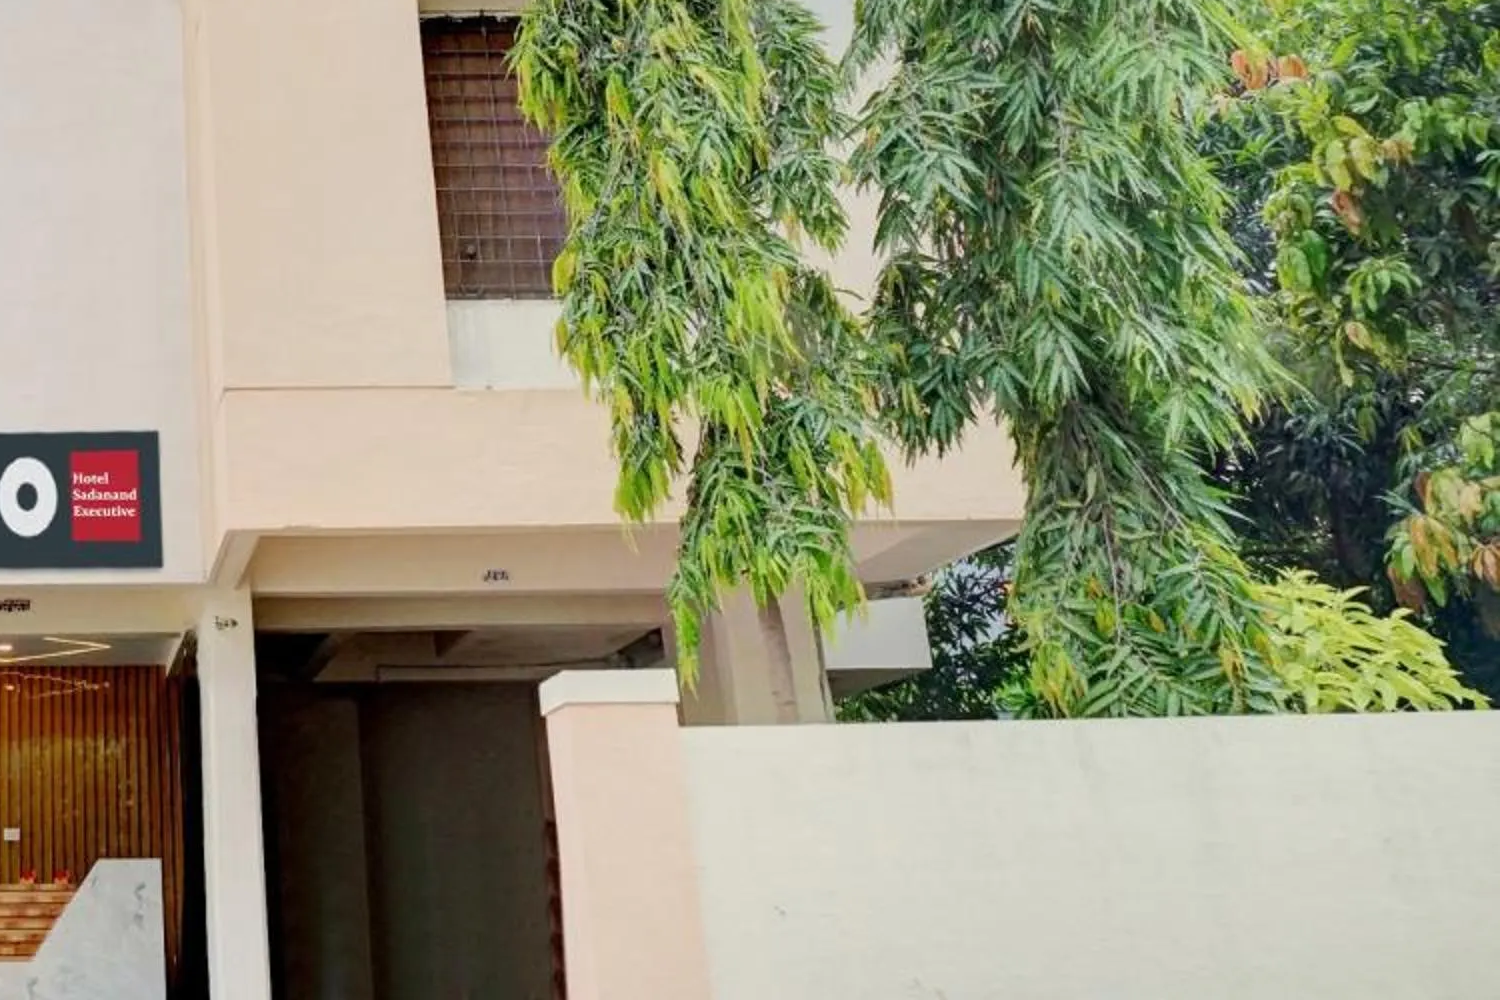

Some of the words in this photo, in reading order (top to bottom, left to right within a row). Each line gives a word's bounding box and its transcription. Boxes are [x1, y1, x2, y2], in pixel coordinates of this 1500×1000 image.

[72, 471, 109, 485] Hotel
[72, 487, 138, 501] Sadanand
[72, 505, 136, 517] Executive
